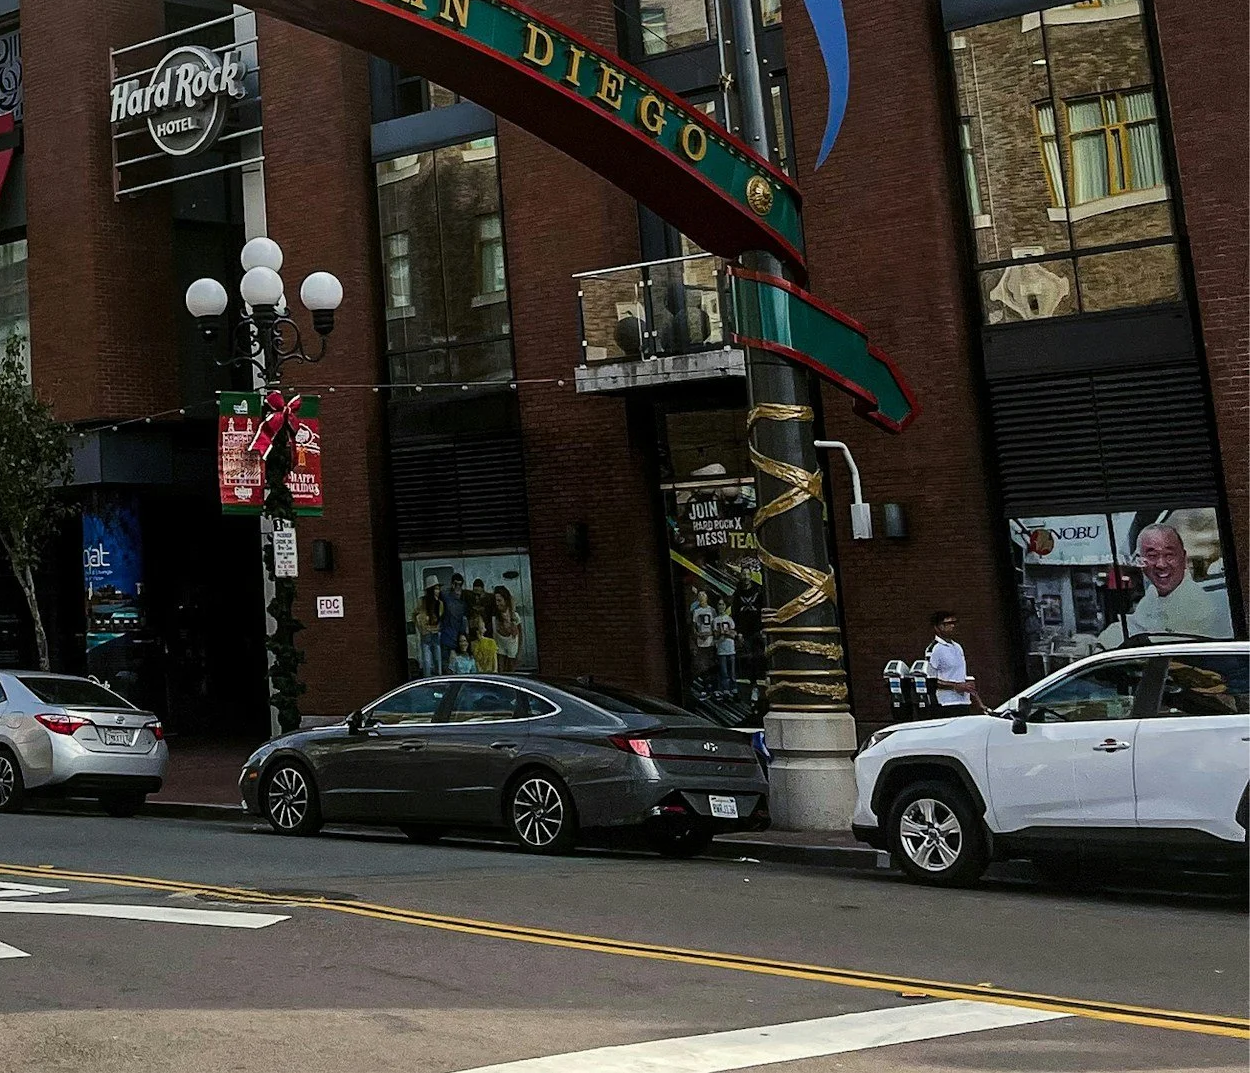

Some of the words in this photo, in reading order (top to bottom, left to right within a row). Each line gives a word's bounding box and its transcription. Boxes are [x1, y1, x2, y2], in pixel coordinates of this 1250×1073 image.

[110, 67, 172, 123] Hard
[175, 51, 243, 108] Rock
[522, 22, 707, 162] DIEGO
[157, 116, 194, 137] HOTEL
[688, 501, 719, 520] JOIN
[692, 520, 713, 532] HARD
[713, 519, 734, 530] ROCK
[734, 516, 742, 530] X
[1049, 525, 1100, 540] NOBU
[696, 530, 728, 547] MESSI
[319, 598, 340, 609] FDC
